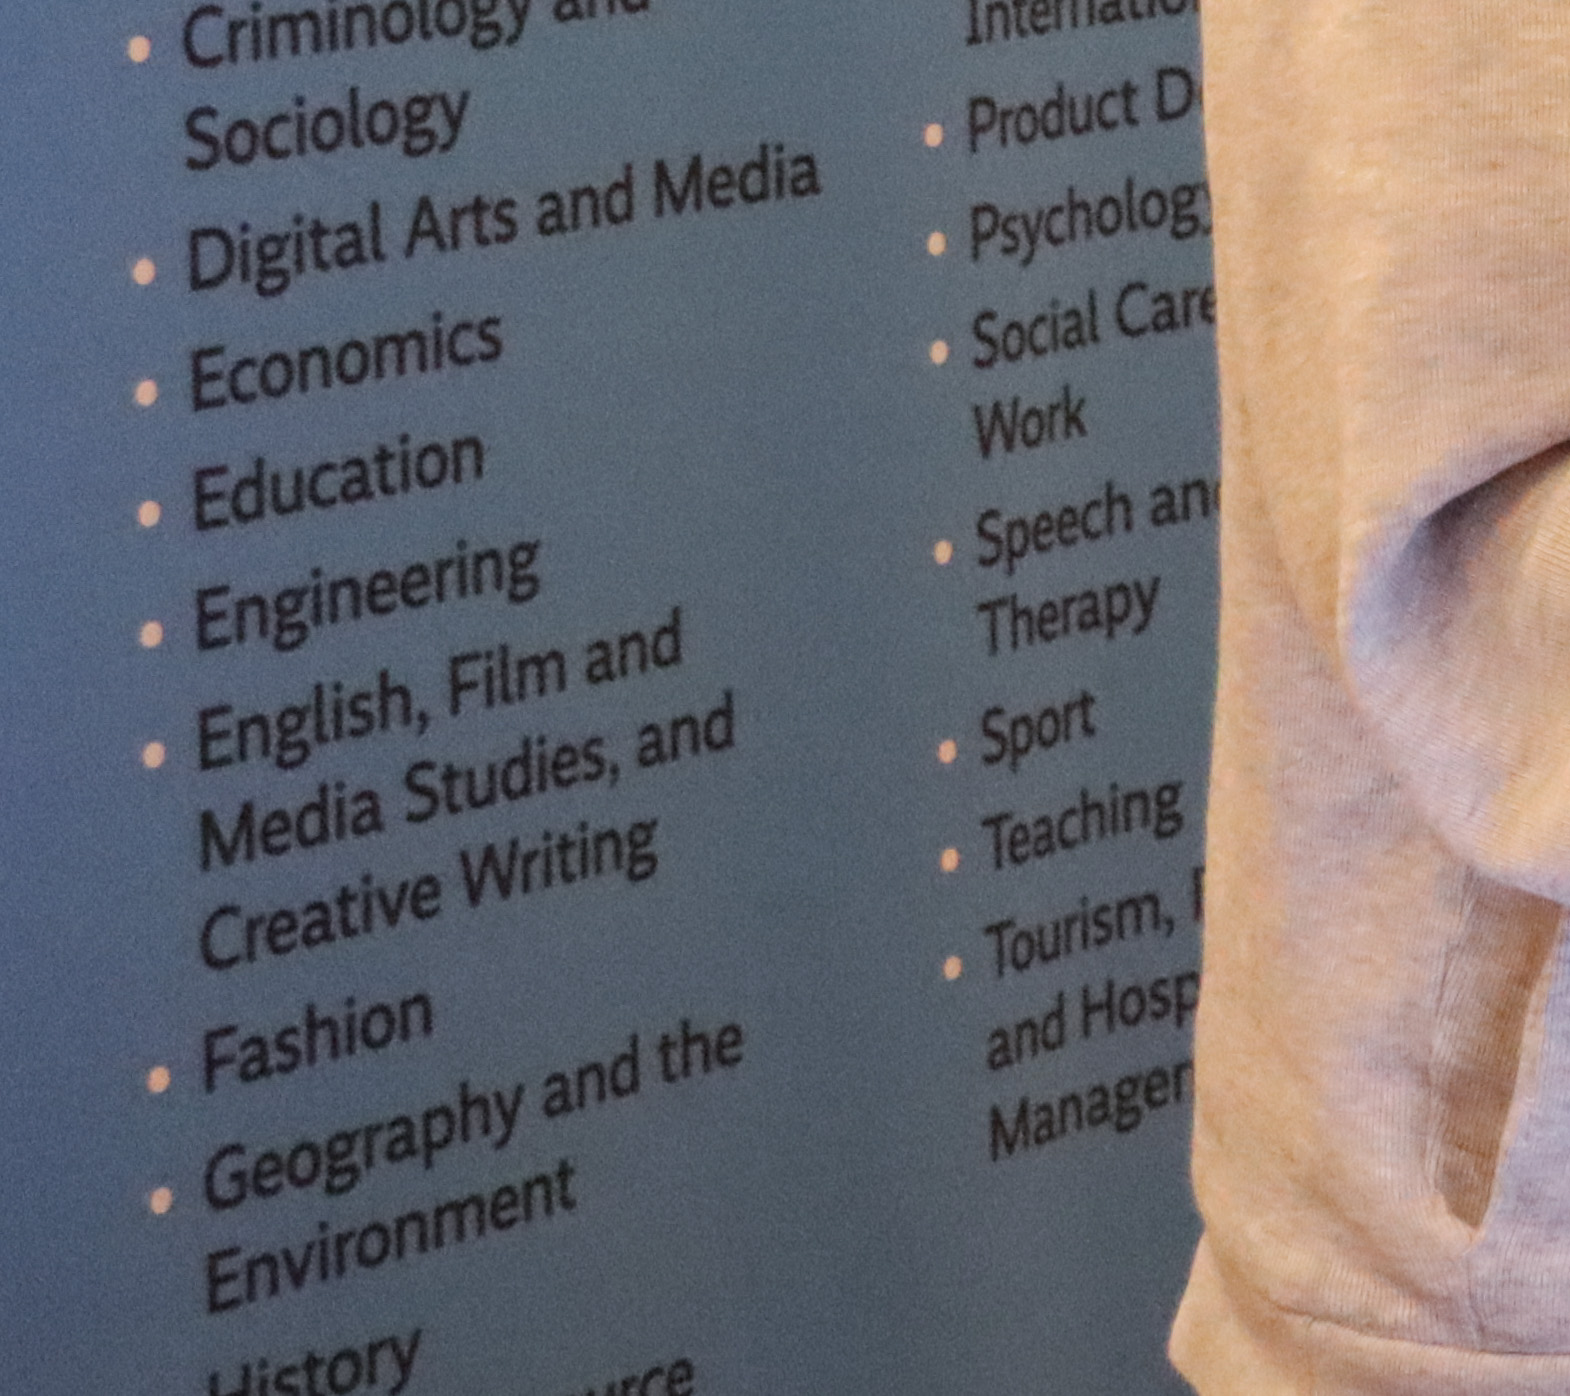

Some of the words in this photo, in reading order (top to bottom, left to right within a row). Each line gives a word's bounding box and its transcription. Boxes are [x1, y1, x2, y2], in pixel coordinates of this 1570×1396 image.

[185, 86, 469, 171] Sociology
[968, 80, 1139, 153] Product
[189, 201, 386, 298] Digital
[404, 175, 517, 258] Arts
[537, 163, 634, 237] and
[654, 143, 821, 217] Media
[190, 311, 502, 412] Economics
[972, 288, 1100, 369] Social
[1114, 281, 1217, 339] Care
[974, 382, 1088, 460] Work
[193, 434, 484, 532] Education
[976, 481, 1133, 576] Speech
[196, 539, 540, 652] Engineering
[976, 576, 1160, 655] Therapy
[198, 669, 430, 771] English,
[449, 644, 566, 716] Film
[585, 607, 681, 685] and
[981, 691, 1096, 772] Sport
[200, 782, 384, 871] Media
[403, 736, 619, 833] Studies,
[637, 690, 734, 768] and
[981, 781, 1184, 870] Teaching
[200, 874, 441, 971] Creative
[459, 819, 658, 907] Writing
[983, 892, 1175, 977] Tourism,
[204, 993, 433, 1093] Fashion
[986, 992, 1066, 1071] and
[1081, 970, 1200, 1038] Hosp
[204, 1081, 524, 1211] Geography
[542, 1034, 640, 1119] and
[657, 1019, 743, 1083] the
[206, 1160, 575, 1314] Environment
